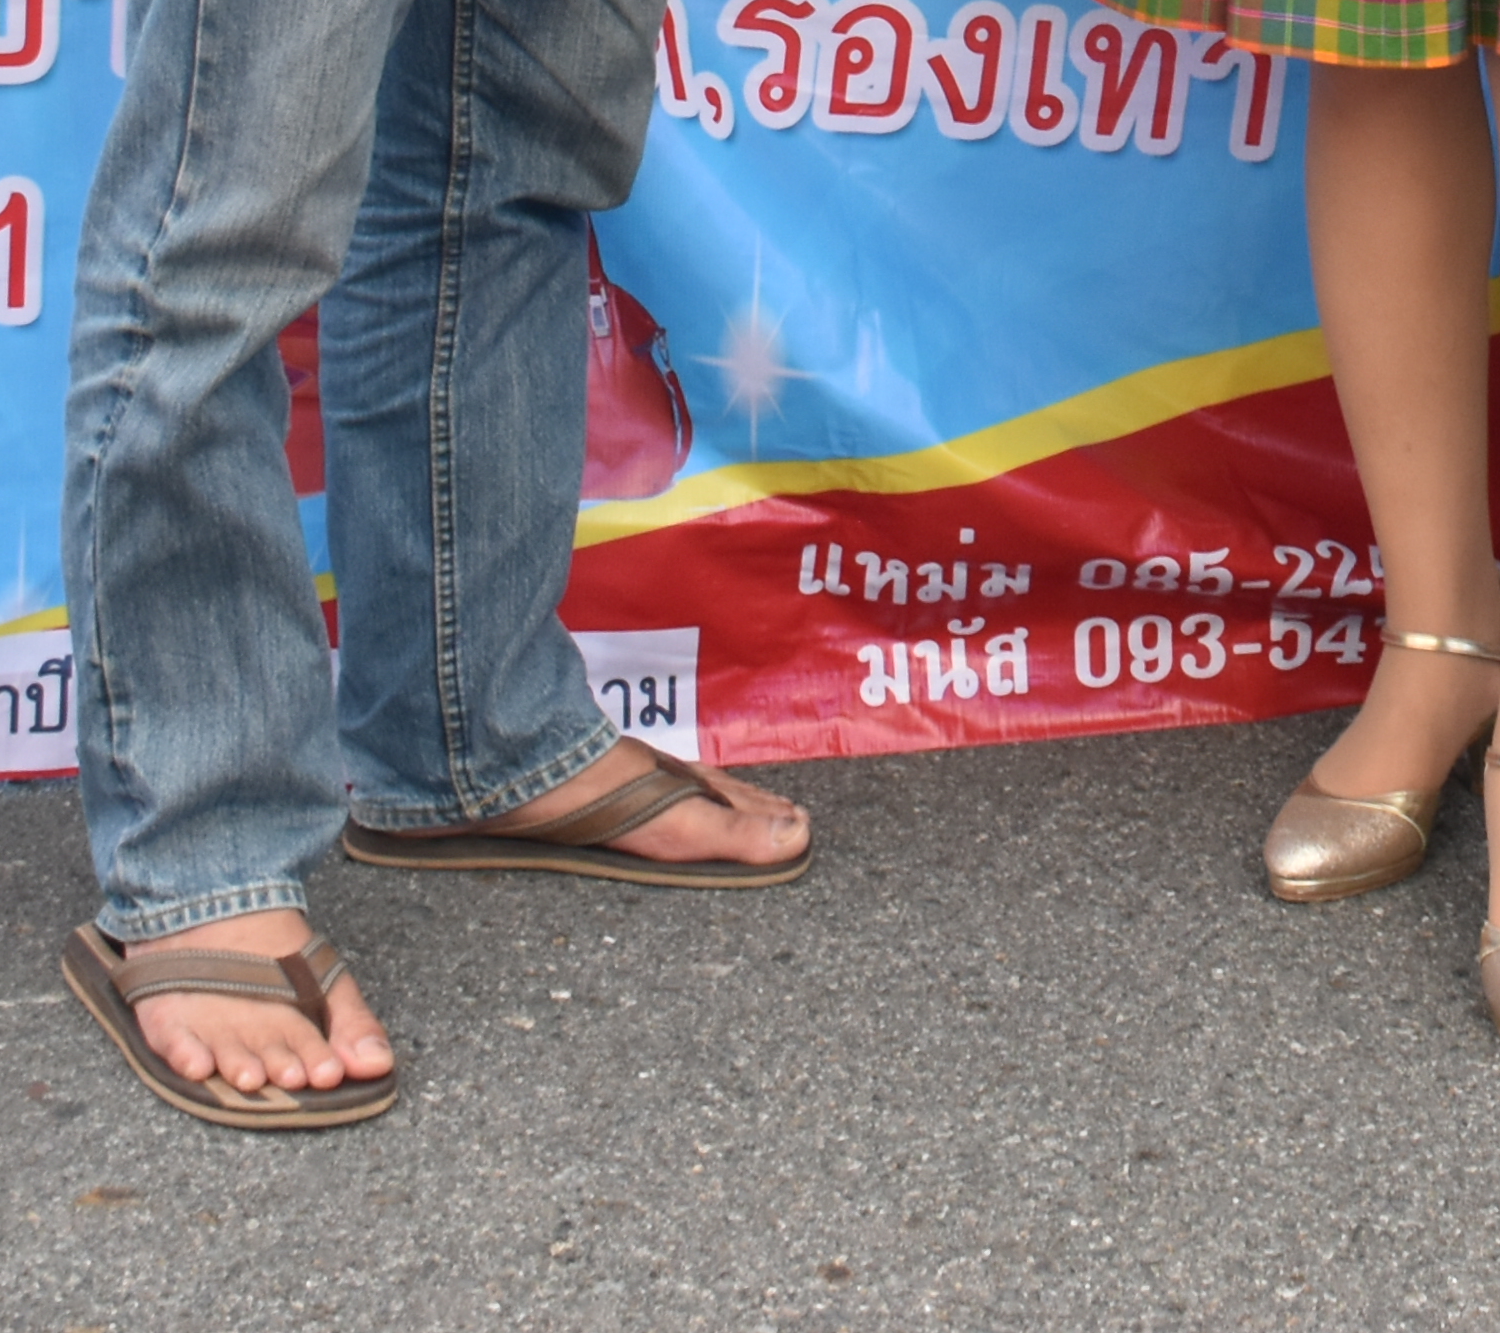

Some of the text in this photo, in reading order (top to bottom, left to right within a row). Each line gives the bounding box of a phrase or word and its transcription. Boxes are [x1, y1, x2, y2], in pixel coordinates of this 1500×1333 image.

[797, 527, 1031, 606] แหม่ม
[857, 612, 1385, 707] มนัส 093-54
